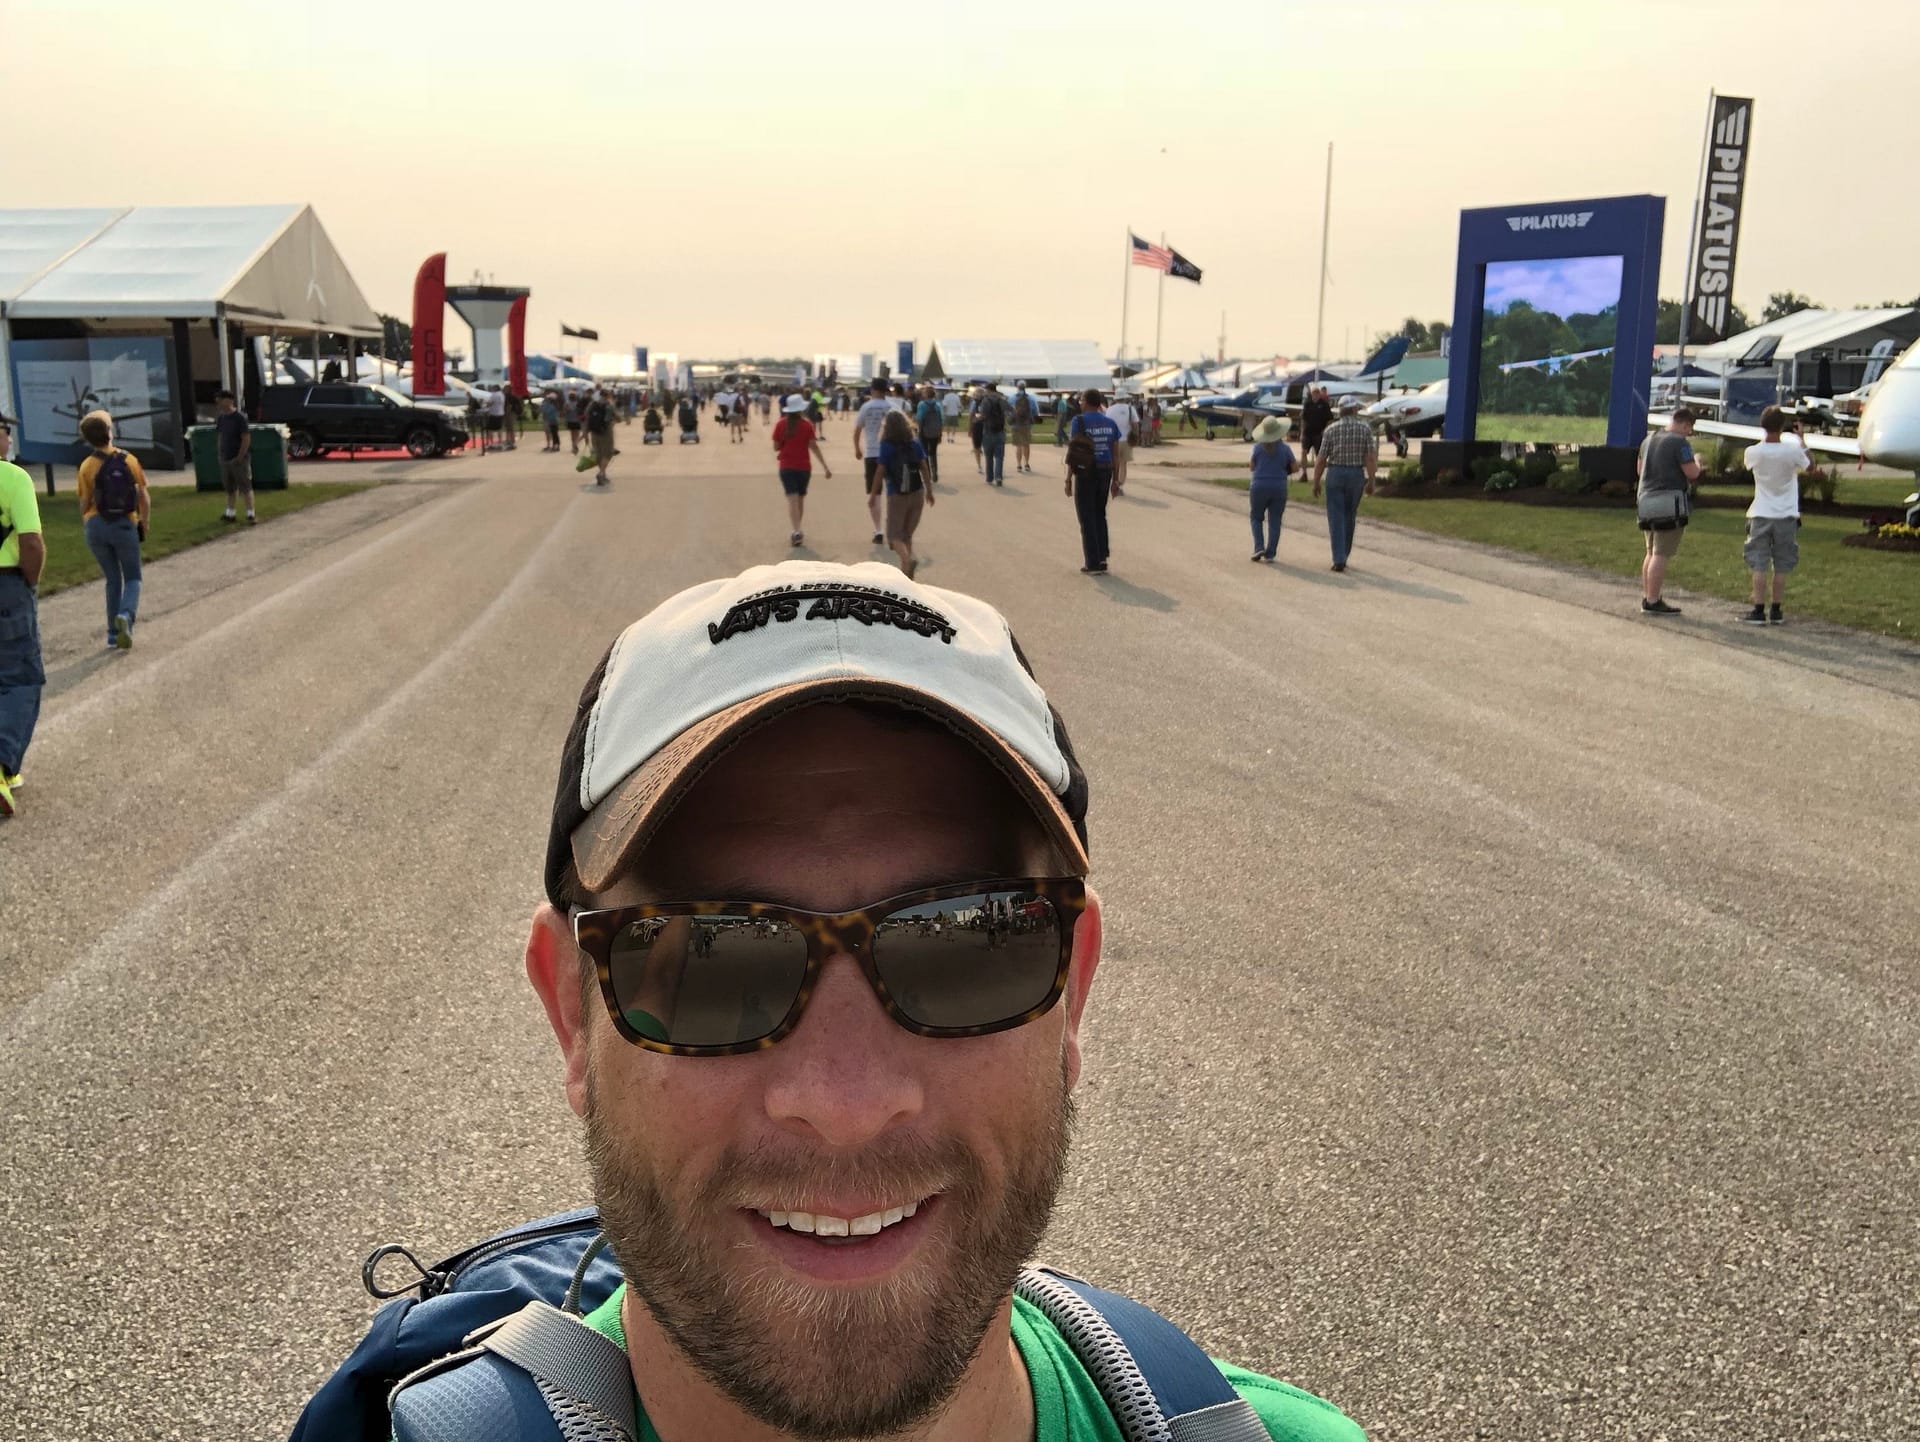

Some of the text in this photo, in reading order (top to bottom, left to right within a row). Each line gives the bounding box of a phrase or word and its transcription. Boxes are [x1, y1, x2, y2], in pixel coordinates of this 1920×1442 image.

[1521, 212, 1578, 231] PILATUS
[1699, 148, 1742, 294] PILATUS
[707, 595, 957, 645] VAN'S AIRCRAFT
